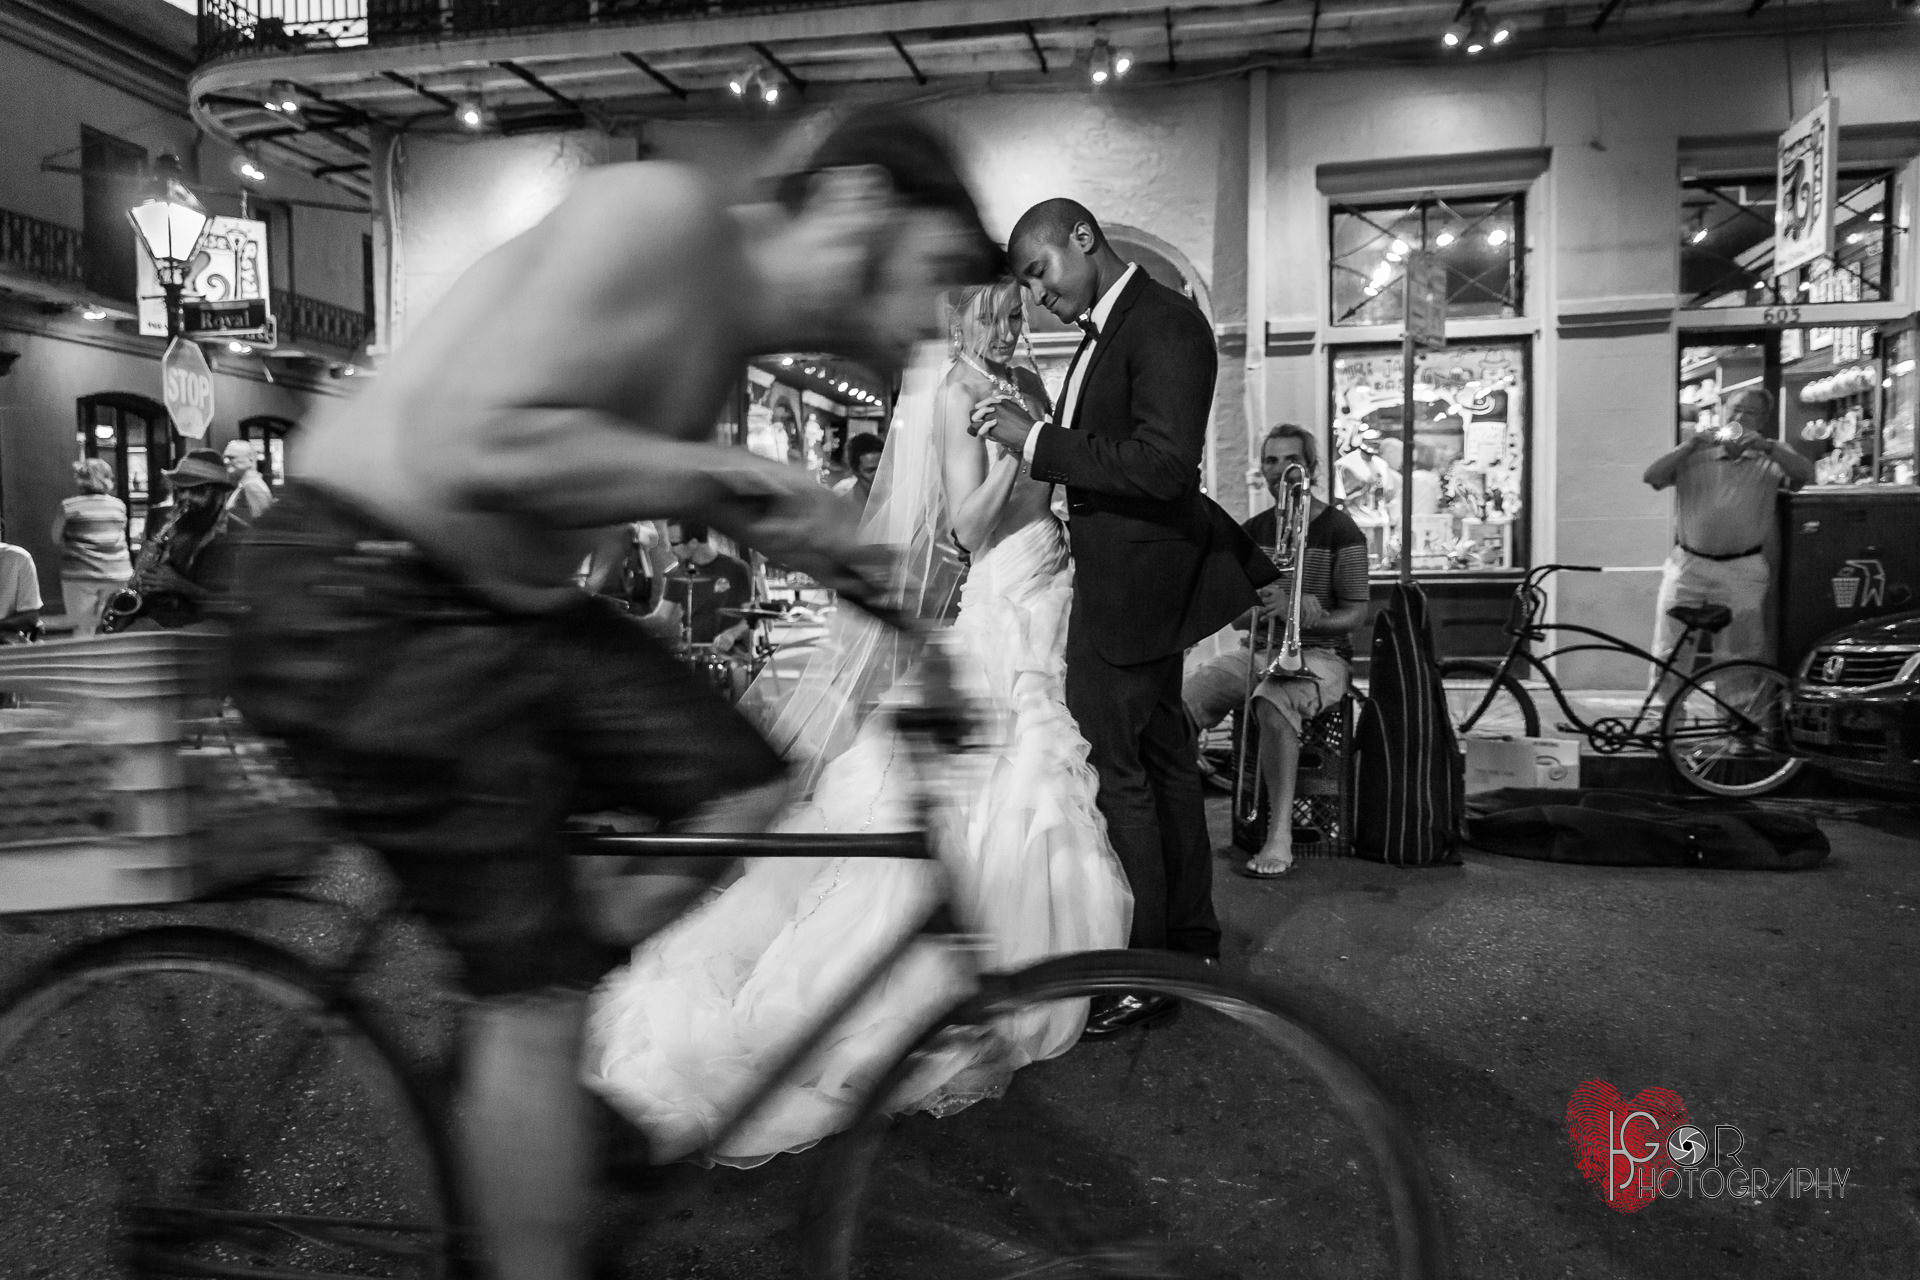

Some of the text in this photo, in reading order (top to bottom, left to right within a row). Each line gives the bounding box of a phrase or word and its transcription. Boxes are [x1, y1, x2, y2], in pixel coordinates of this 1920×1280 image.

[201, 309, 250, 330] Royal
[1763, 307, 1801, 324] 603
[167, 366, 210, 409] STOP
